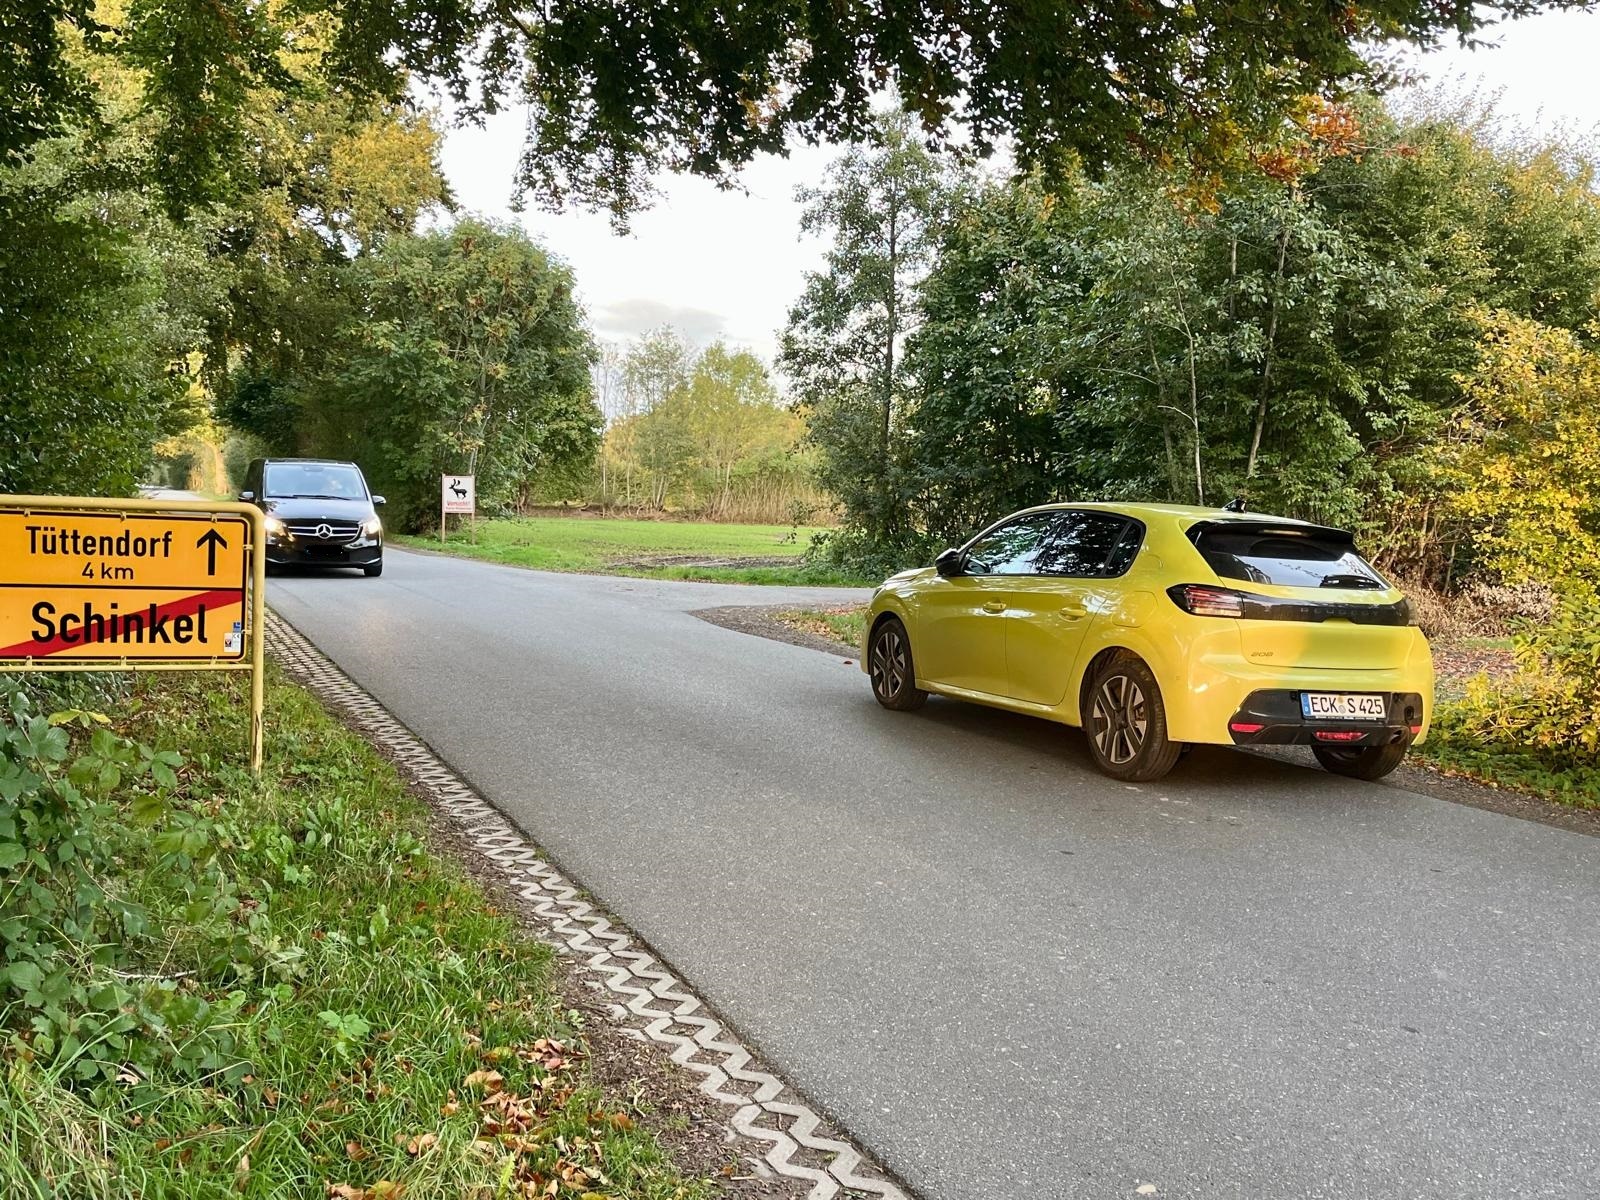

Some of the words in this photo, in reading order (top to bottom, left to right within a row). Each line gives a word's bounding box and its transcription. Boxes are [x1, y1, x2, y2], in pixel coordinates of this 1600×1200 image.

[25, 526, 172, 557] Tüttendorf
[82, 562, 94, 579] 4
[101, 563, 134, 580] km
[32, 601, 207, 643] Schinkel
[1310, 697, 1339, 713] ECK
[1347, 697, 1356, 714] S
[1359, 697, 1383, 715] 425
